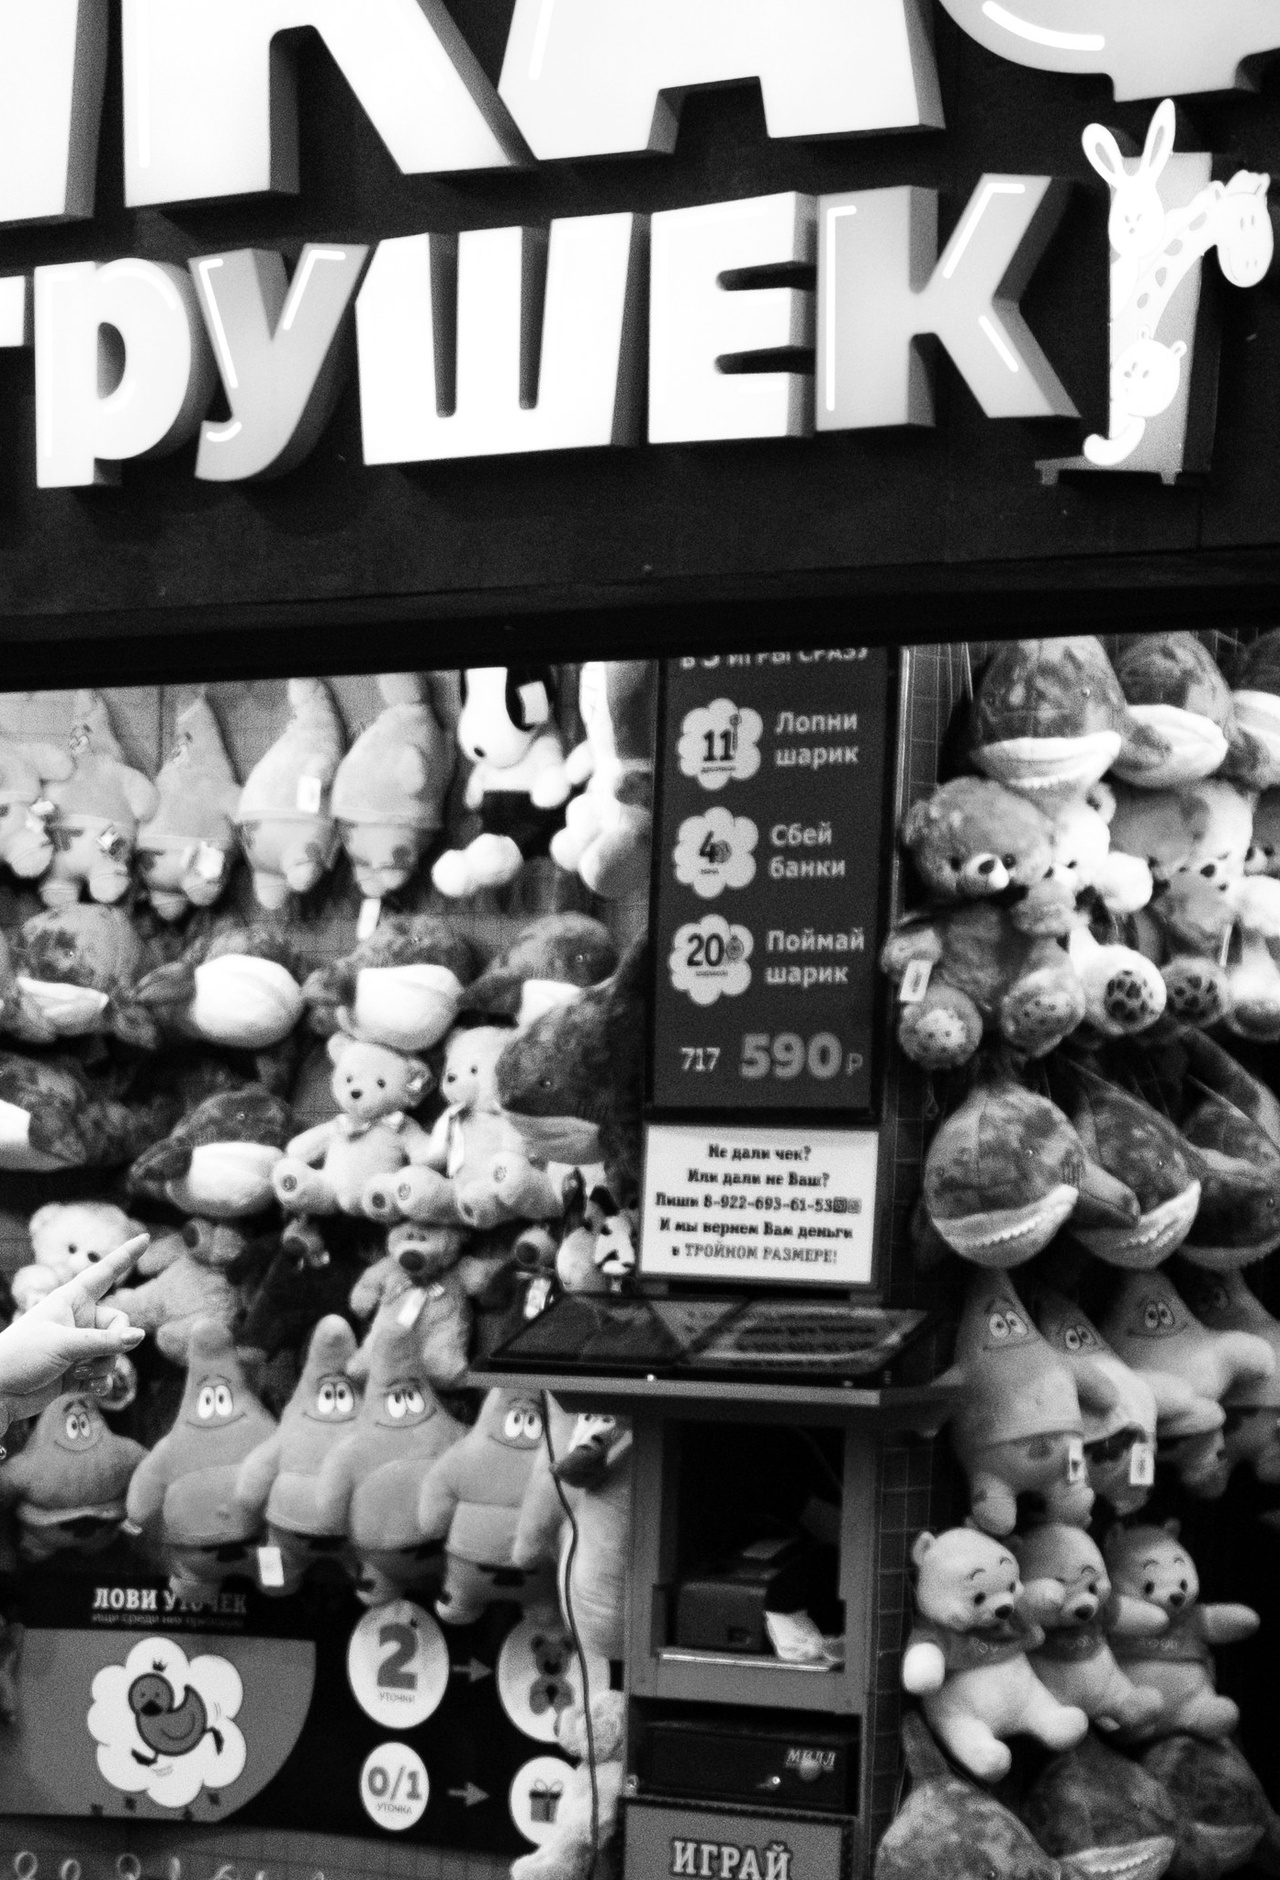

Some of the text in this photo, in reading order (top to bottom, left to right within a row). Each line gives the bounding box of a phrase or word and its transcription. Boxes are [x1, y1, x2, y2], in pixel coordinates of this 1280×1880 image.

[776, 711, 858, 733] Лопни
[703, 729, 735, 762] 11
[775, 746, 859, 770] шарик
[771, 821, 833, 847] Сбей
[770, 856, 847, 880] банки
[686, 932, 725, 967] 20
[767, 927, 866, 951] Поймай
[765, 966, 850, 988] шарик
[681, 1047, 721, 1072] 717
[740, 1031, 843, 1081] 590
[709, 1144, 812, 1162] Не дали чек?
[687, 1168, 830, 1188] Или дали не Ваш?
[655, 1191, 699, 1207] Пиши
[660, 1217, 671, 1231] И
[675, 1221, 698, 1233] мы
[763, 1221, 794, 1236] Вам
[798, 1225, 854, 1239] деньги
[684, 1241, 759, 1260] ТРОЙНОМ
[762, 1248, 838, 1264] РАЗМЕРЕ!
[92, 1587, 157, 1611] ЛОВИ
[377, 1622, 418, 1690] 2
[368, 1765, 423, 1801] 0/1
